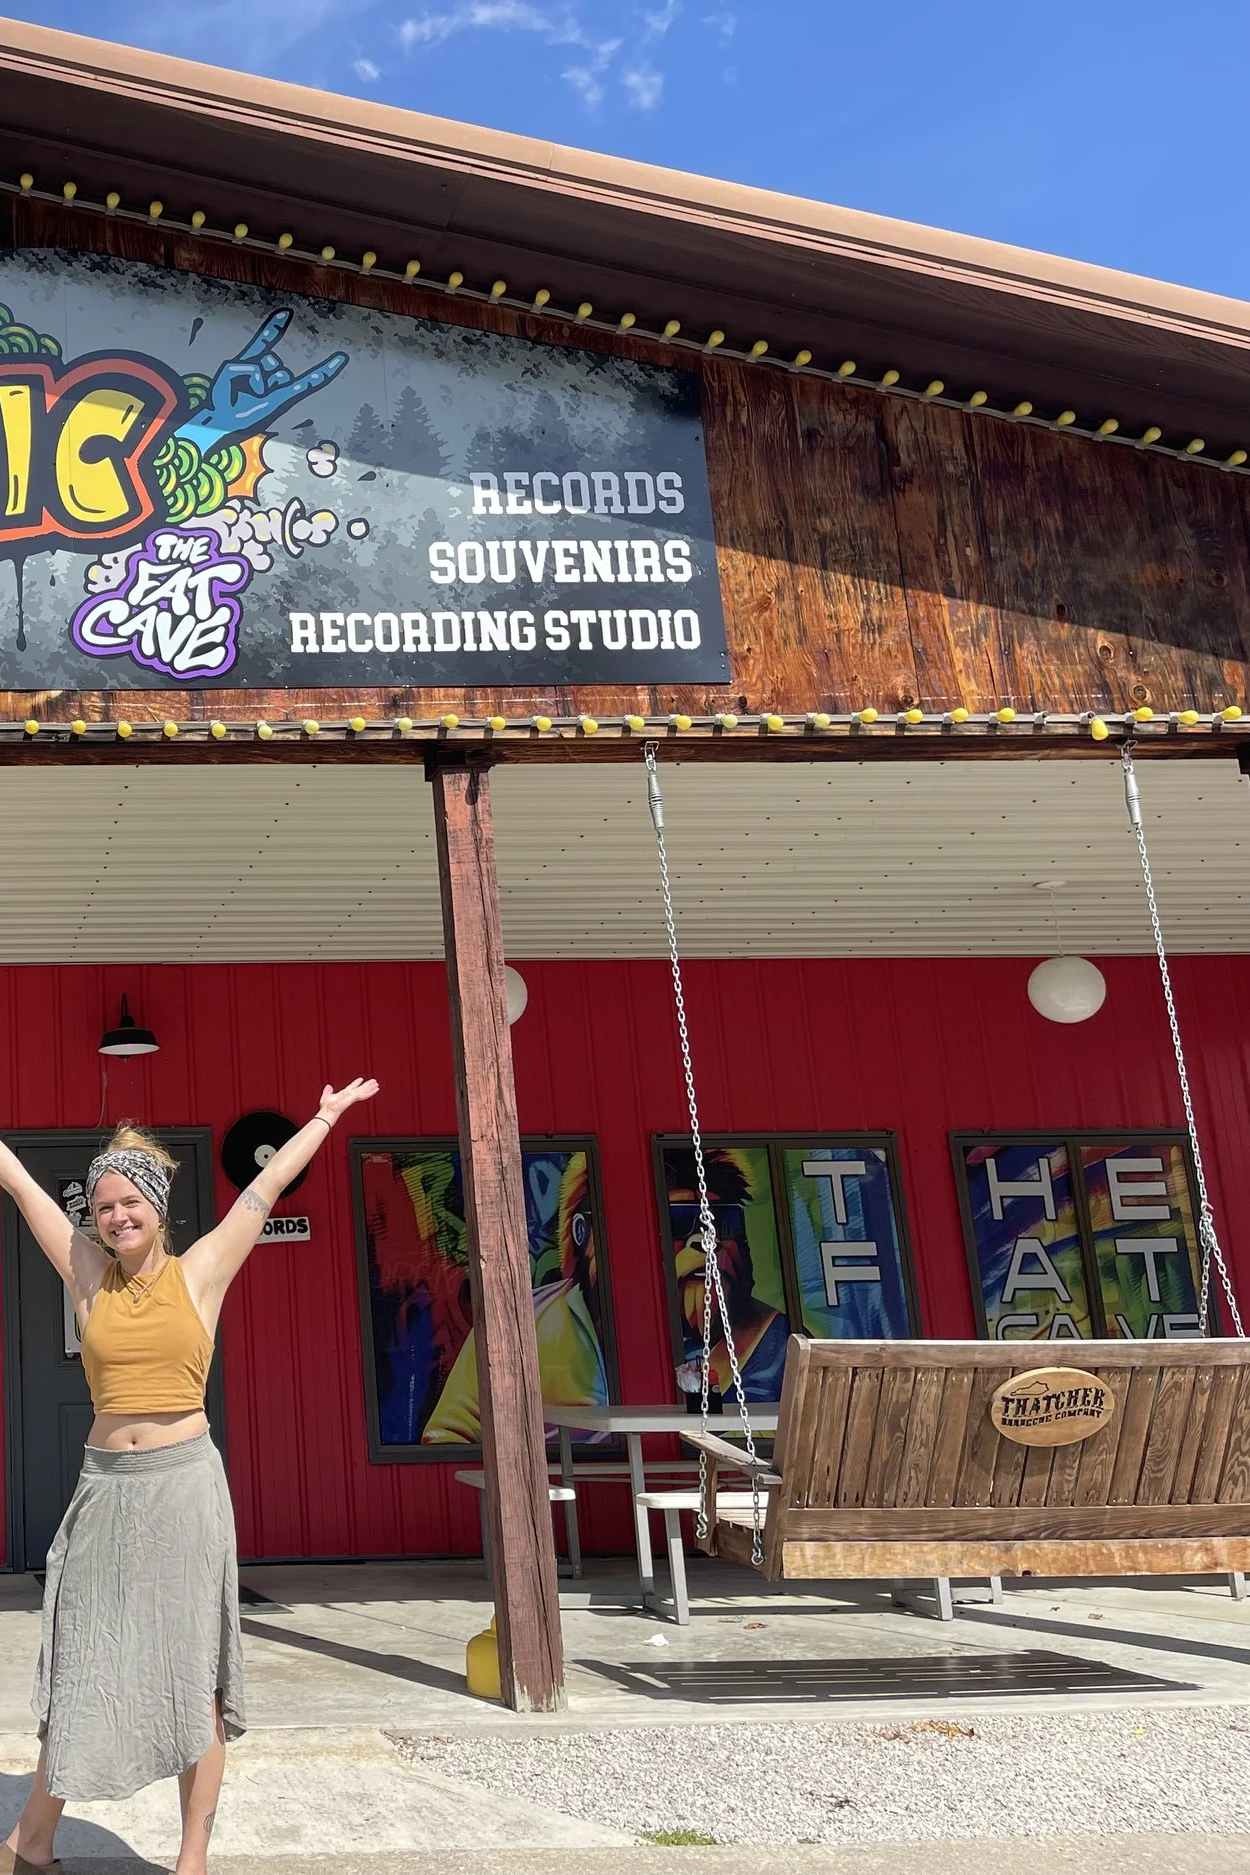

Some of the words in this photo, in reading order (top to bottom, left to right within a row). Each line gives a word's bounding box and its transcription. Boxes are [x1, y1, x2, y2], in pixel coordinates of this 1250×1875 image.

[470, 471, 685, 515] RECORDS
[155, 534, 212, 564] THE
[428, 539, 693, 584] SOUVENIRS
[128, 560, 242, 620] FAT
[81, 599, 231, 672] CAVE
[290, 612, 537, 654] RECORDING
[545, 609, 701, 650] STUDIO
[264, 1218, 308, 1236] ORDS
[1001, 1387, 1105, 1418] THATCHER
[1001, 1414, 1052, 1427] BARBECUE
[1055, 1408, 1102, 1421] COMPANY
